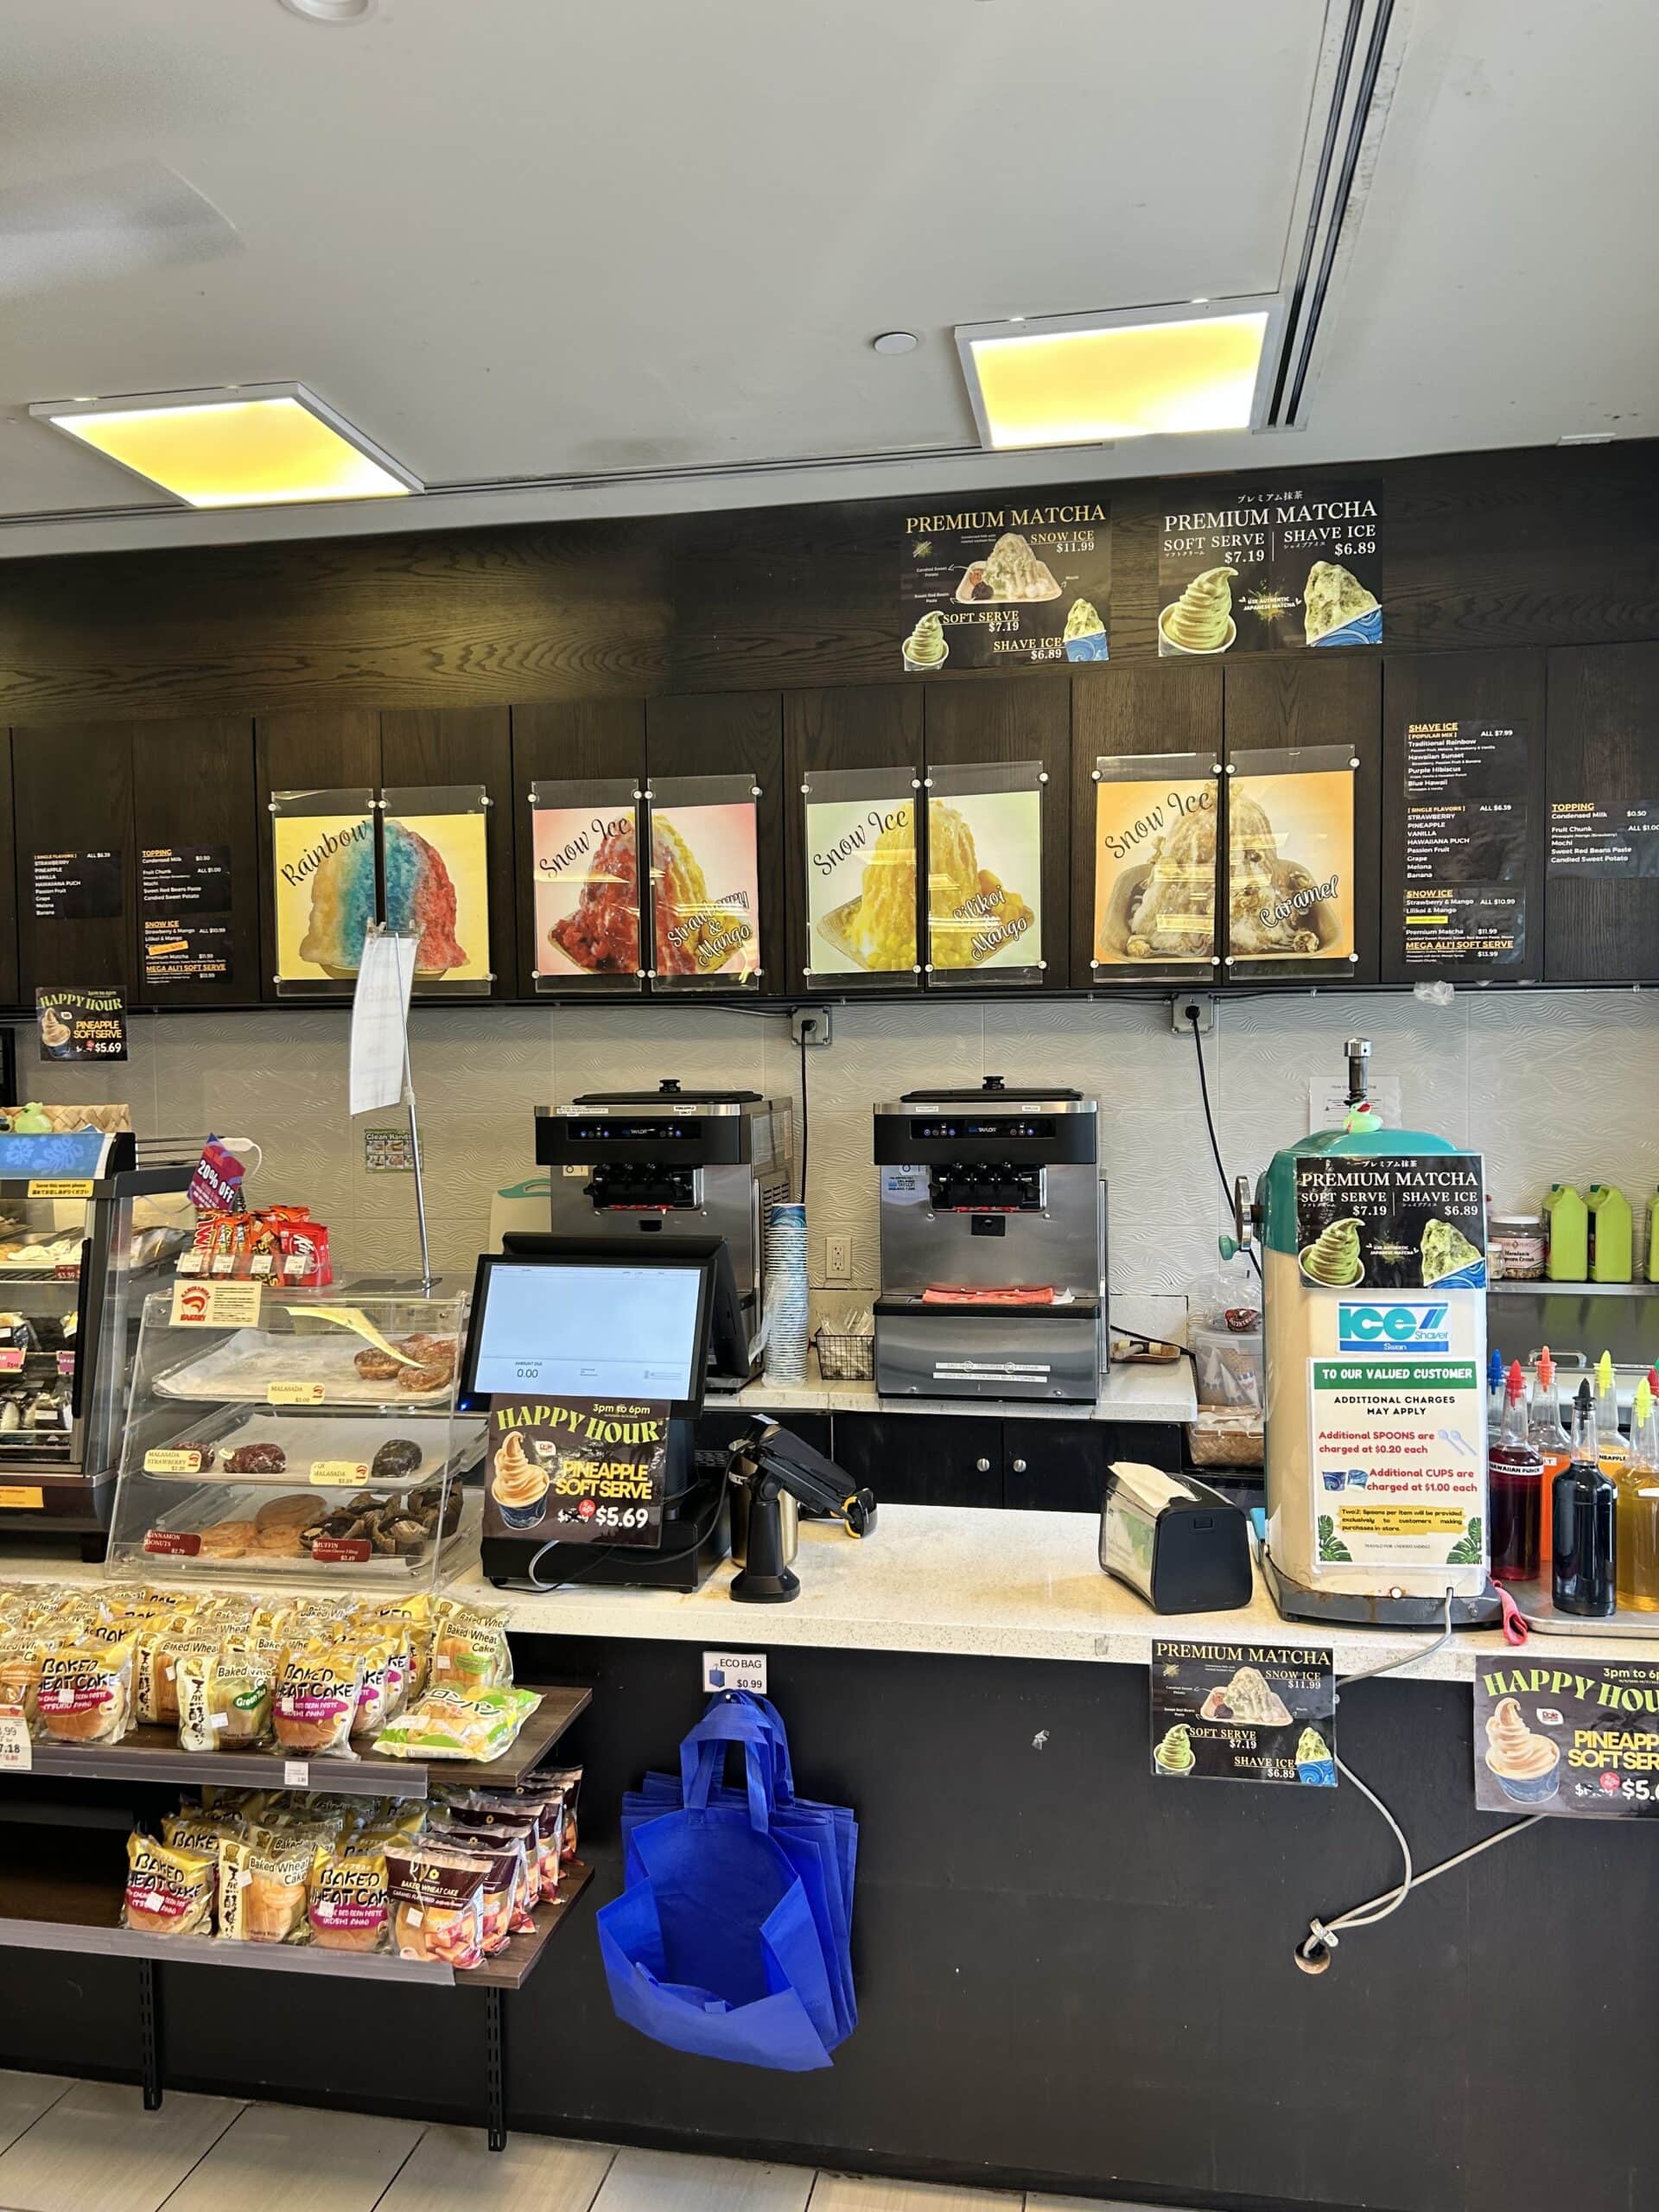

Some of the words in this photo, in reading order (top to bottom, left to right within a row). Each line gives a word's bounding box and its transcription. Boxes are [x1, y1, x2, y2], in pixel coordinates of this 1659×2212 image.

[906, 512, 1004, 533] PREMIUM
[1012, 504, 1106, 526] MATCHA
[1164, 509, 1270, 532] PREMIUM
[1276, 500, 1377, 524] MATCHA
[1031, 532, 1068, 543] SNOW
[1073, 531, 1094, 540] ICE
[1284, 528, 1341, 543] SHAVE
[1348, 525, 1376, 537] ICE
[1057, 542, 1094, 553] $11.99
[1164, 537, 1205, 551] SOFT
[1211, 533, 1264, 547] SERVE
[1335, 542, 1376, 556] $6.89
[1224, 550, 1264, 563] $7.19
[943, 613, 975, 624] SOFT
[979, 611, 1020, 621] SERVE
[988, 622, 1020, 632] $7.19
[994, 639, 1035, 651] SHAVE
[1040, 638, 1062, 647] ICE
[1031, 649, 1062, 659] $6.89
[1409, 723, 1442, 732] SHAVE
[1443, 722, 1459, 731] ICE
[1105, 805, 1165, 859] Snow
[1166, 792, 1212, 817] Ice
[540, 831, 591, 879] Snow
[591, 817, 631, 841] Ice
[814, 825, 867, 875] Snow
[868, 810, 909, 834] Ice
[281, 821, 368, 887] Rainbow
[1260, 874, 1338, 927] Caramel
[709, 919, 722, 936] &
[698, 924, 750, 966] Mango
[971, 918, 1027, 960] Mango
[40, 994, 85, 1007] HAPPY
[86, 998, 123, 1011] HOUR
[76, 1020, 119, 1029] PINEAPPLE
[73, 1030, 95, 1039] SOFT
[95, 1042, 121, 1052] $5.69
[198, 1160, 219, 1188] 20%
[219, 1182, 234, 1203] OFF
[1302, 1173, 1390, 1186] PREMIUM
[1395, 1173, 1478, 1186] MATCHA
[1301, 1192, 1337, 1203] SOFT
[1341, 1192, 1387, 1202] SERVE
[1402, 1192, 1449, 1202] SHAVE
[1455, 1192, 1478, 1202] ICE
[1352, 1205, 1387, 1217] $7.19
[1445, 1205, 1478, 1217] $6.89
[517, 1368, 538, 1378] 0.00
[1322, 1369, 1337, 1379] TO
[1341, 1369, 1362, 1378] OUR
[1367, 1369, 1409, 1379] VALUED
[1414, 1369, 1472, 1378] CUSTOMER
[593, 1404, 614, 1414] 3pm
[629, 1406, 650, 1414] 6pm
[497, 1405, 586, 1433] HAPPY
[585, 1416, 660, 1445] HOUR
[1319, 1431, 1370, 1440] Additional
[1319, 1445, 1359, 1454] charged
[1376, 1446, 1402, 1454] $0.20
[563, 1460, 649, 1481] PINEAPPLE
[1370, 1469, 1422, 1478] Additional
[1426, 1469, 1453, 1478] CUPS
[556, 1478, 599, 1496] SOFT
[600, 1481, 652, 1499] SERVE
[1367, 1484, 1408, 1493] charged
[1425, 1484, 1450, 1492] $1.00
[595, 1506, 648, 1529] $5.69
[447, 1624, 467, 1637] Baked
[470, 1630, 497, 1644] Wheat
[472, 1643, 495, 1653] Cake
[1157, 1643, 1243, 1661] PREMIUM
[1249, 1648, 1331, 1665] MATCHA
[41, 1659, 99, 1673] BAKED
[721, 1659, 740, 1668] ECO
[741, 1660, 761, 1669] BAG
[218, 1668, 247, 1677] Baked
[284, 1663, 334, 1681] BAKED
[1265, 1670, 1298, 1679] SNOW
[1603, 1668, 1630, 1679] 3pm
[1633, 1669, 1646, 1679] to
[737, 1680, 762, 1688] $0.99
[1288, 1680, 1321, 1689] $11.99
[1483, 1669, 1595, 1700] HAPPY
[1597, 1682, 1659, 1713] HOU
[1189, 1728, 1217, 1737] SOFT
[1221, 1730, 1256, 1739] SERVE
[1230, 1739, 1256, 1749] $7.19
[1574, 1730, 1659, 1751] PINEAPP
[1234, 1757, 1272, 1767] SHAVE
[1276, 1758, 1294, 1768] ICE
[1568, 1749, 1623, 1769] SOFT
[1624, 1751, 1659, 1770] SER
[1268, 1769, 1294, 1778] $6.89
[136, 1853, 185, 1882] BAKED
[250, 1858, 275, 1873] Baked
[278, 1858, 311, 1873] Wheat
[284, 1872, 307, 1885] Cake
[321, 1870, 379, 1886] BAKED
[401, 1880, 420, 1890] BAKED
[422, 1885, 442, 1894] WHEAT
[443, 1888, 460, 1897] CAKE
